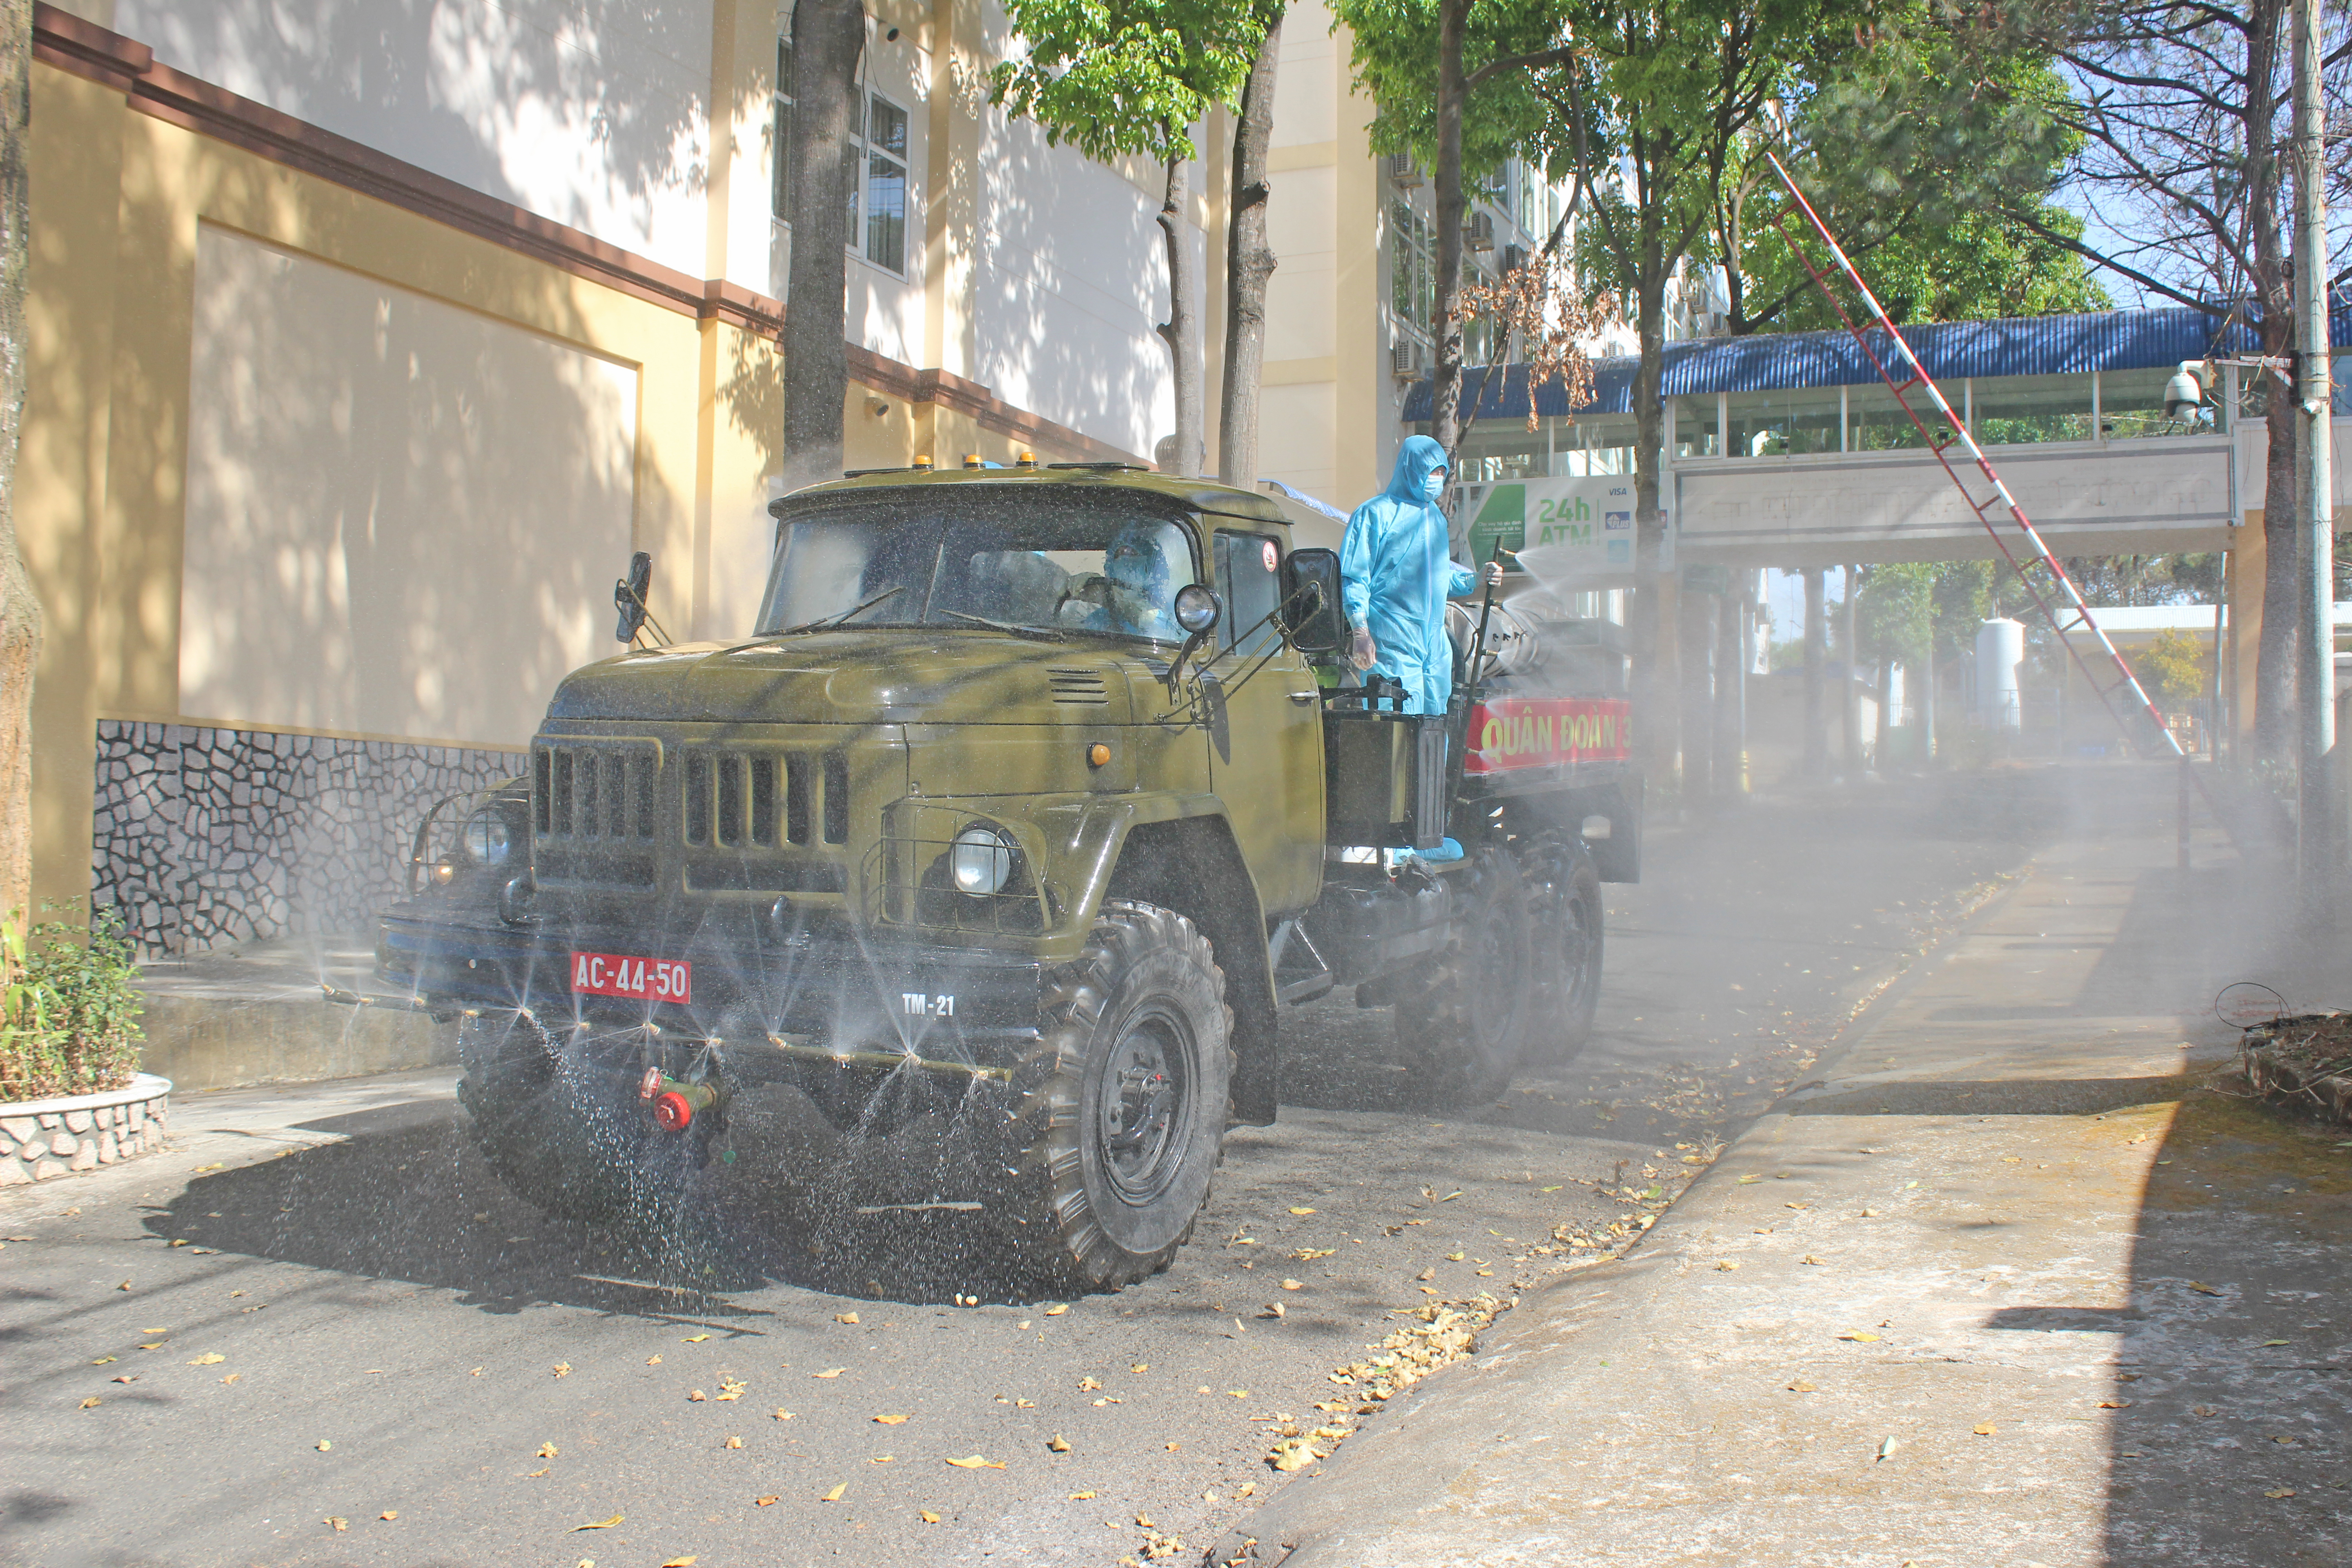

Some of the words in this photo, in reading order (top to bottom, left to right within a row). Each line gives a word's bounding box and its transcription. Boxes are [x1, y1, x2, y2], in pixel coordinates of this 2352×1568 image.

[1609, 487, 1627, 496] VISA
[1539, 497, 1590, 522] 24h
[1539, 525, 1590, 546] ATM
[1612, 520, 1630, 528] PLUS
[1481, 706, 1552, 764] QUÂN
[1560, 705, 1616, 750] ĐOÀN
[1622, 715, 1632, 748] 3
[576, 955, 686, 997] AC-44-50
